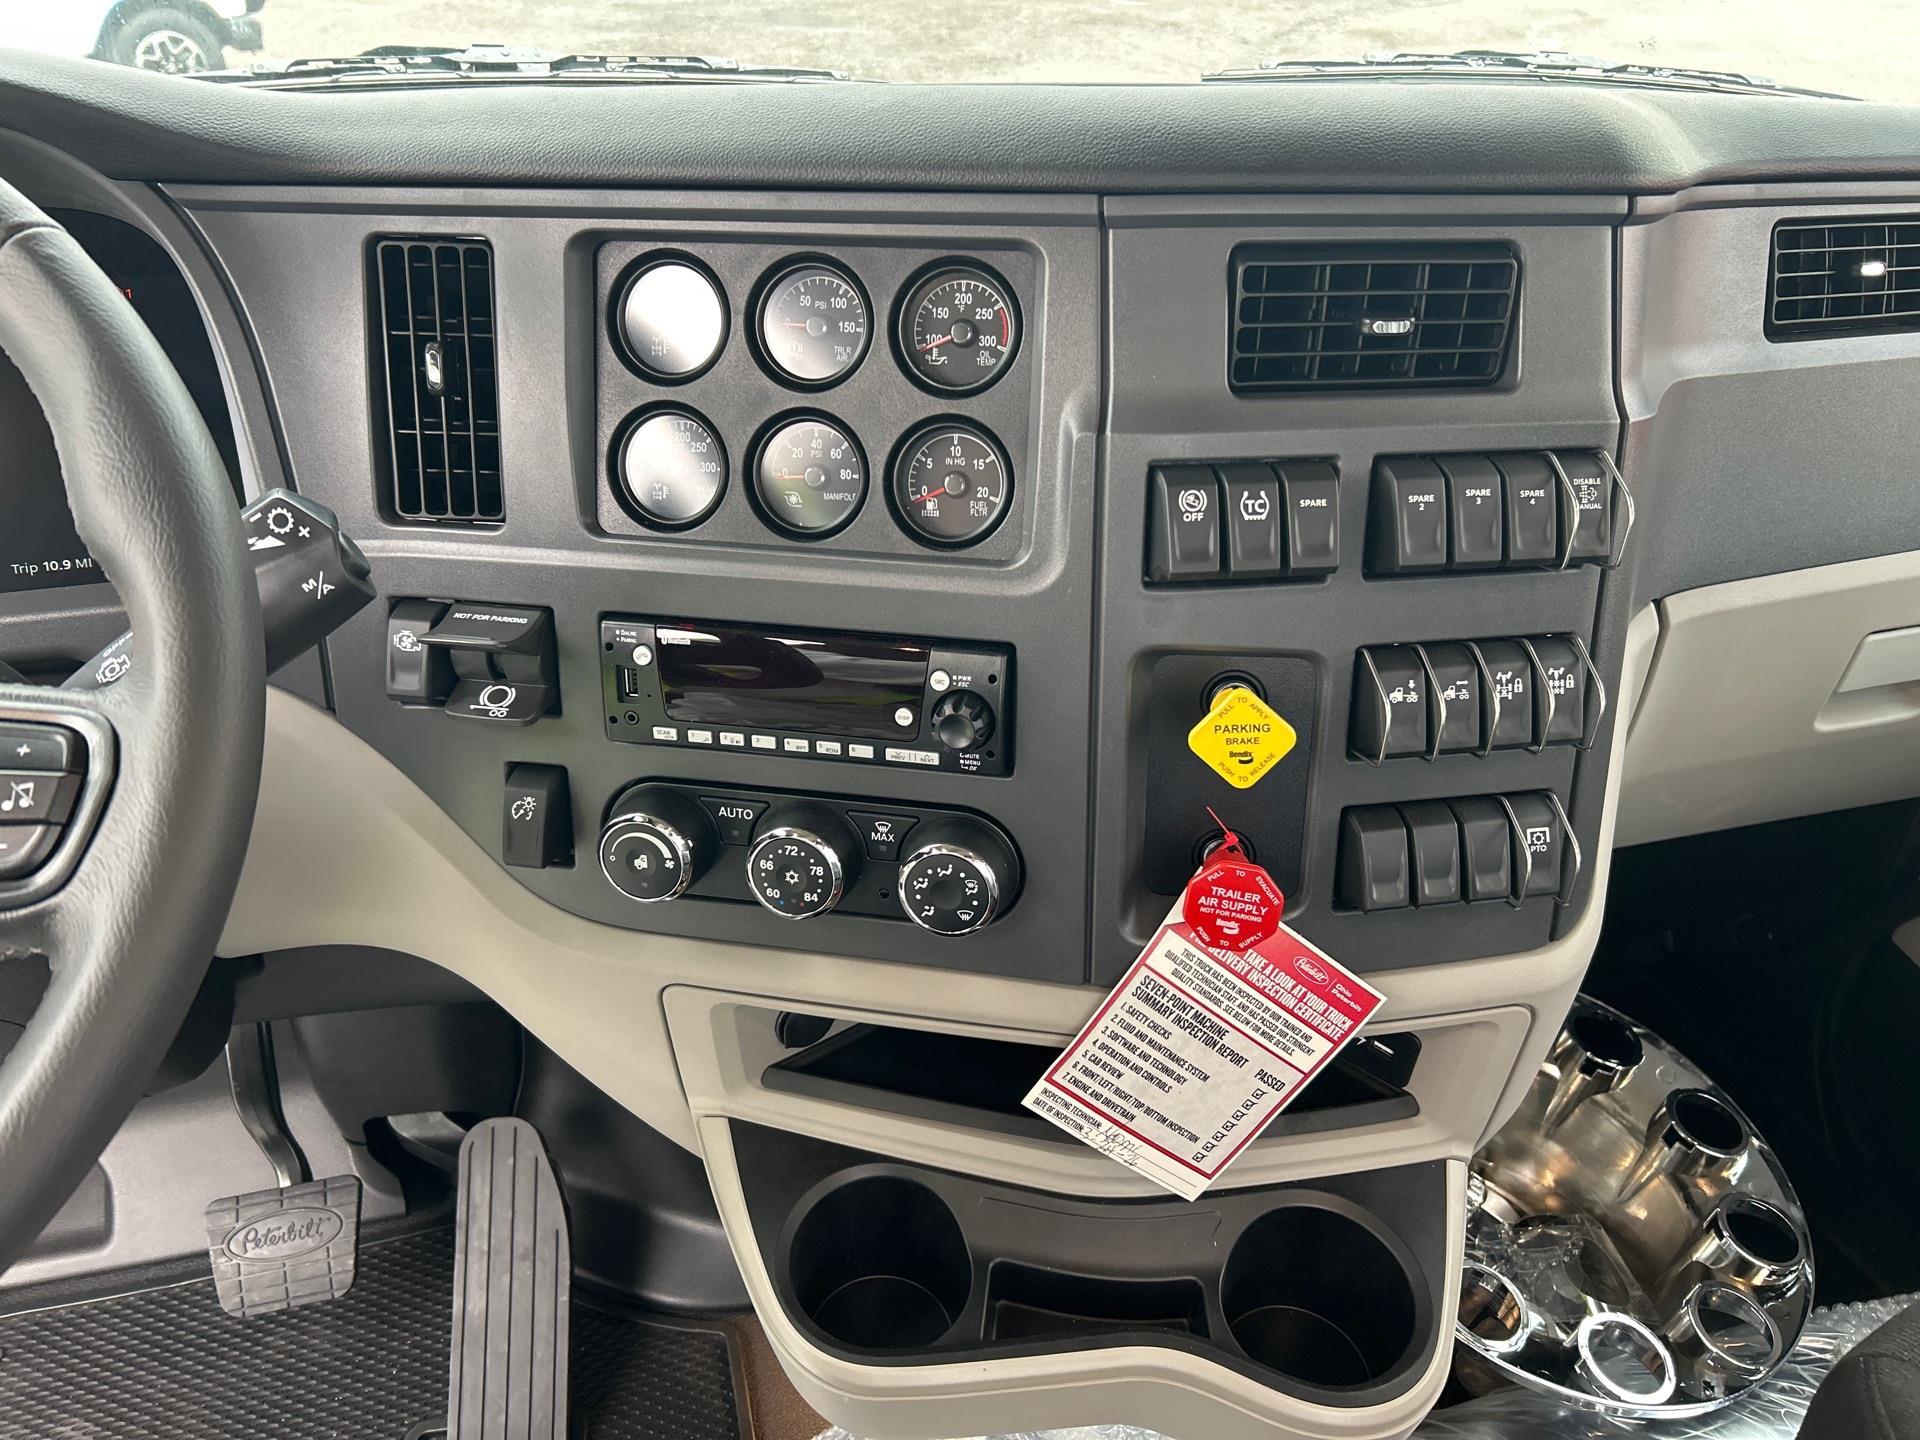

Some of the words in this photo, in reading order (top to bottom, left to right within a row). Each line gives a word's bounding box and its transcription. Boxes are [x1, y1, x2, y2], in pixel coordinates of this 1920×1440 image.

[800, 296, 811, 306] 50
[815, 301, 826, 309] PSI
[831, 297, 847, 309] 100
[955, 293, 972, 305] 200
[932, 307, 949, 318] 150
[975, 308, 993, 320] 250
[839, 321, 855, 333] 150
[926, 334, 943, 345] 100
[979, 336, 997, 347] 300
[834, 346, 852, 355] TRLR
[979, 351, 990, 359] OIL
[837, 353, 848, 362] AIR
[976, 358, 996, 366] TEMP
[674, 432, 690, 442] 200
[691, 442, 707, 453] 250
[811, 439, 822, 449] 40
[792, 448, 802, 458] 20
[830, 449, 842, 459] 60
[811, 450, 823, 458] PSI
[950, 446, 961, 456] 10
[700, 462, 716, 472] 300
[927, 458, 933, 469] 5
[973, 459, 985, 470] 15
[840, 469, 852, 480] 80
[922, 485, 928, 496] 0
[977, 487, 988, 498] 20
[1465, 488, 1491, 498] SPARE
[1520, 489, 1545, 499] SPARE
[970, 501, 988, 509] FUEL
[1299, 499, 1327, 508] SPARE
[1408, 494, 1435, 504] SPARE
[1476, 497, 1482, 505] 3
[1530, 497, 1536, 505] 4
[970, 509, 988, 517] FLTR
[1245, 500, 1265, 513] TC
[1418, 503, 1425, 511] 2
[1183, 512, 1204, 522] OFF
[11, 563, 38, 576] Trip
[43, 560, 71, 572] 10.9
[75, 558, 93, 568] MI
[301, 571, 335, 599] M/A
[490, 615, 528, 624] PARKING
[1218, 705, 1234, 718] PULL
[1249, 703, 1270, 720] APPLY
[1215, 724, 1271, 734] PARKING
[1225, 737, 1260, 745] BRAKE
[1219, 762, 1235, 777] PUSH
[1249, 752, 1276, 776] RELEASE
[719, 806, 753, 820] AUTO
[871, 832, 895, 842] MAX
[784, 846, 798, 856] 72
[760, 860, 774, 870] 66
[809, 866, 824, 876] 78
[1207, 870, 1224, 882] PULL
[1255, 876, 1280, 906] EVACUATE
[1211, 886, 1261, 903] TRAILER
[766, 888, 780, 899] 60
[804, 892, 818, 902] 84
[1198, 896, 1218, 907] AIR
[1221, 900, 1268, 916] SUPPLY
[1216, 909, 1230, 917] FOR
[1231, 912, 1262, 922] PARKING
[1216, 919, 1240, 928] Bendix
[1197, 926, 1211, 942] PUSH
[1238, 932, 1263, 948] SUPPLY
[1241, 948, 1268, 971] TAKE
[1262, 962, 1275, 976] A
[1268, 967, 1297, 991] LOOK
[1179, 948, 1196, 962] THIS
[1192, 956, 1214, 974] TRUCK
[1210, 969, 1224, 982] HAS
[1220, 977, 1238, 991] BEEN
[1233, 986, 1265, 1010] INSPECTED
[1260, 1005, 1272, 1015] BY
[1268, 1010, 1282, 1022] OUR
[1278, 1017, 1302, 1036] TRAINED
[1299, 1031, 1313, 1043] AND
[1290, 983, 1307, 998] AT
[1336, 983, 1352, 997] Ohio
[1138, 974, 1196, 1016] SEVEN-POINT
[1189, 1009, 1229, 1040] MACHINE
[1163, 949, 1194, 973] QUALIFIED
[1189, 968, 1224, 994] TECHNICIAN
[1235, 1000, 1250, 1013] AND
[1246, 1008, 1260, 1020] HAS
[1256, 1015, 1279, 1032] PASSED
[1275, 1027, 1289, 1039] OUR
[1285, 1034, 1315, 1056] STRINGENT
[1170, 967, 1195, 987] QUALITY
[1222, 1004, 1235, 1015] SEE
[1231, 1010, 1252, 1026] BELOW
[1248, 1022, 1262, 1033] FOR
[1259, 1029, 1276, 1042] MORE
[1245, 968, 1299, 1009] INSPECTION
[1292, 1001, 1345, 1041] CERTIFICATE
[1300, 990, 1329, 1013] YOUR
[1331, 989, 1362, 1012] Peterbilt
[1124, 1005, 1150, 1024] SAFETY
[1145, 1019, 1173, 1040] CHECKS
[1321, 1005, 1354, 1031] TRUCK
[1130, 985, 1176, 1020] SUMMARY
[1170, 1013, 1221, 1050] INSPECTION
[1215, 1043, 1249, 1069] REPORT
[1116, 1017, 1137, 1034] FLUID
[1132, 1028, 1149, 1042] AND
[1144, 1037, 1189, 1068] MAINTENANCE
[1183, 1063, 1210, 1082] SYSTEM
[1106, 1029, 1140, 1055] SOFTWARE
[1136, 1049, 1152, 1063] AND
[1148, 1057, 1188, 1086] TECHNOLOGY
[1087, 1053, 1102, 1066] CAB
[1099, 1061, 1124, 1079] REVIEW
[1096, 1041, 1132, 1067] OPERATION
[1127, 1061, 1144, 1075] AND
[1139, 1070, 1173, 1094] CONTROLS
[1253, 1068, 1286, 1092] PASSED
[1039, 1087, 1073, 1110] INSPECTING
[1066, 1075, 1092, 1094] ENGINE
[1087, 1088, 1104, 1101] AND
[1099, 1096, 1137, 1122] DRIVETRAIN
[1032, 1097, 1048, 1109] DATE
[1044, 1104, 1056, 1114] OF
[1165, 1119, 1200, 1143] INSPECTION
[243, 1217, 324, 1255] Peterbilt
